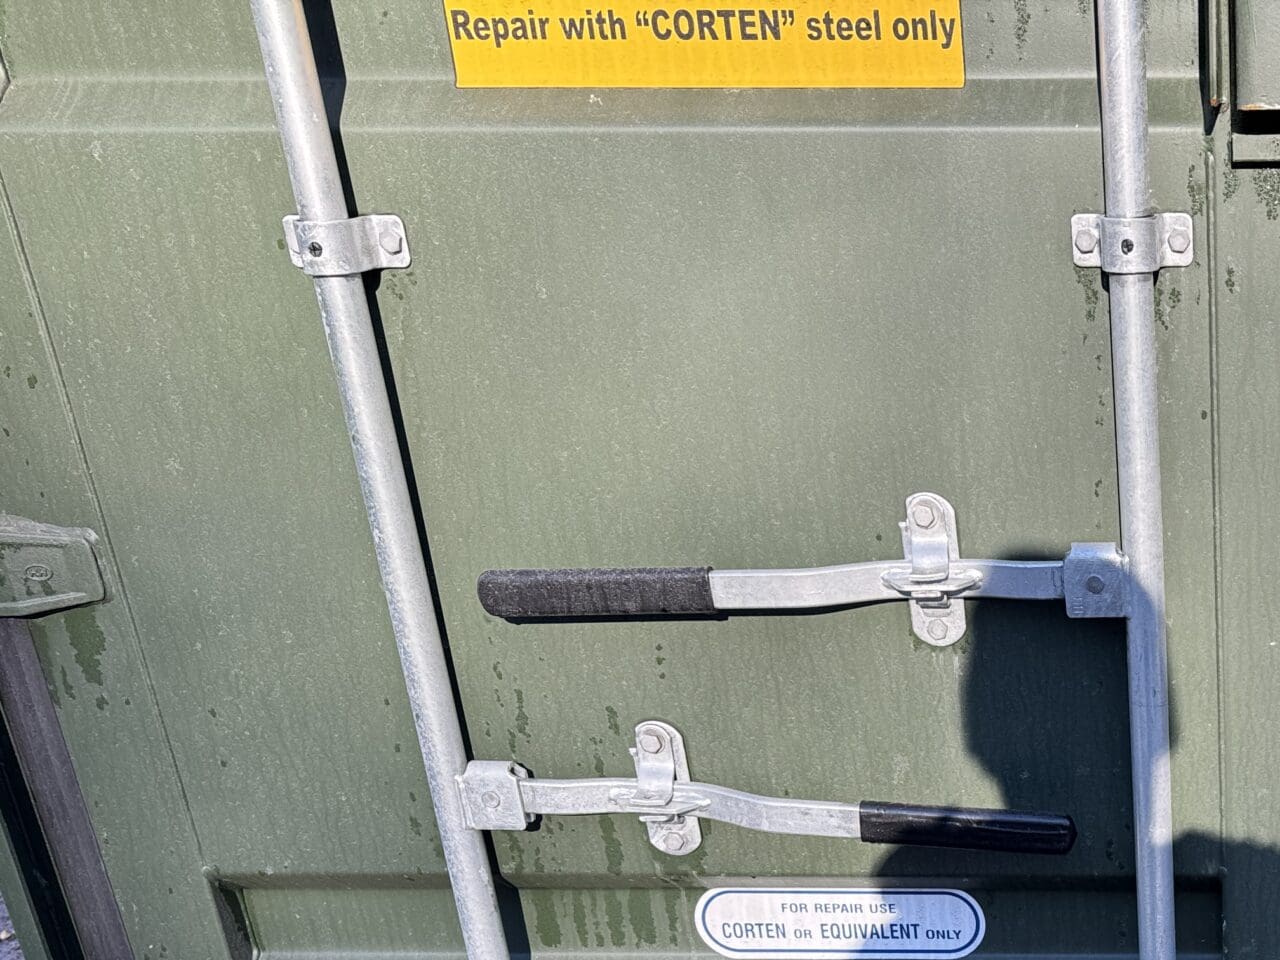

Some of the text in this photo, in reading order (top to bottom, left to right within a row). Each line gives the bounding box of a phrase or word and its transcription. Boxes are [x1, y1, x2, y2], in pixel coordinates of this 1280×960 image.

[453, 8, 956, 49] Repair with “CORTEN” steel only
[781, 903, 896, 914] FOR REPAIR USE
[721, 922, 962, 940] CORTEN OR EQUIVALENT ONLY
